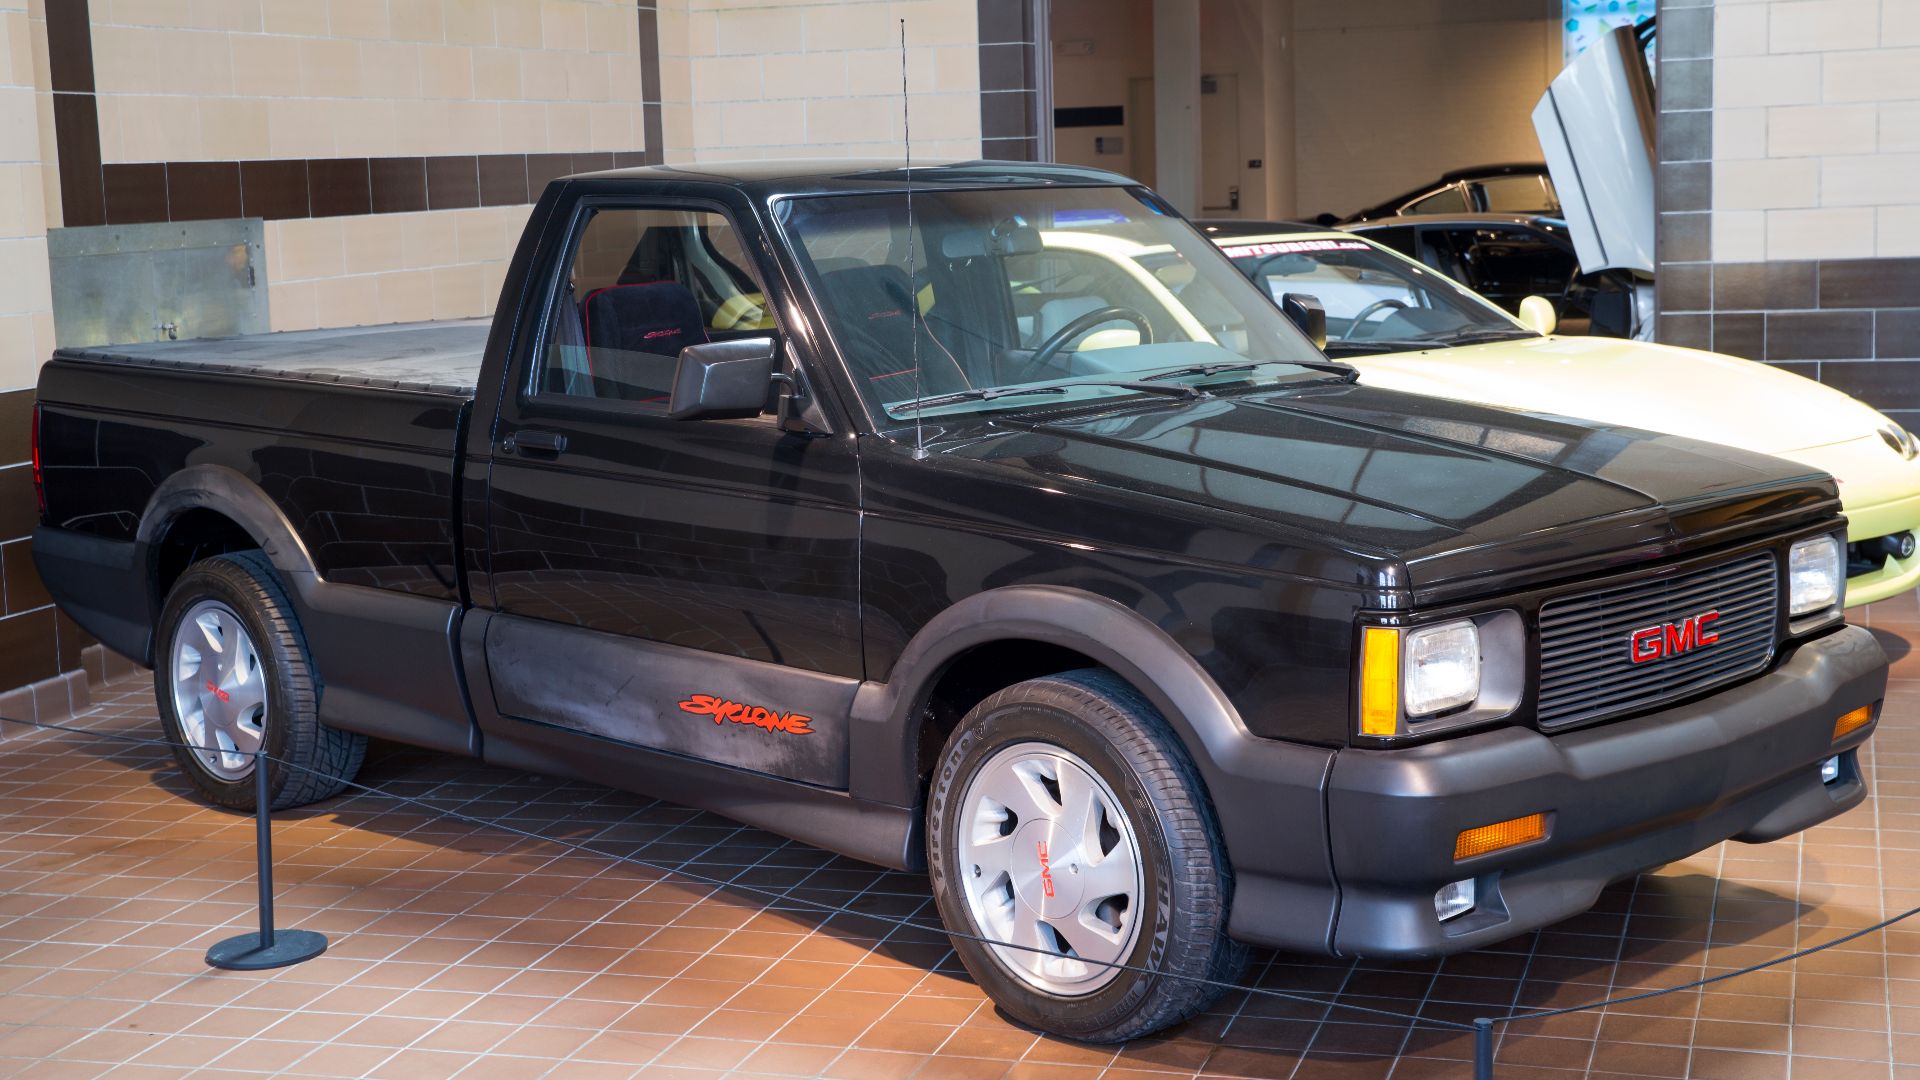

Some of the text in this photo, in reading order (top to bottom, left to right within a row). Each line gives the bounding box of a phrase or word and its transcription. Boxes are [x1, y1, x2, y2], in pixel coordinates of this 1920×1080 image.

[1631, 609, 1720, 663] GMC
[678, 694, 816, 735] SYCLONE
[931, 738, 970, 881] Firestone
[1036, 840, 1055, 897] GMC
